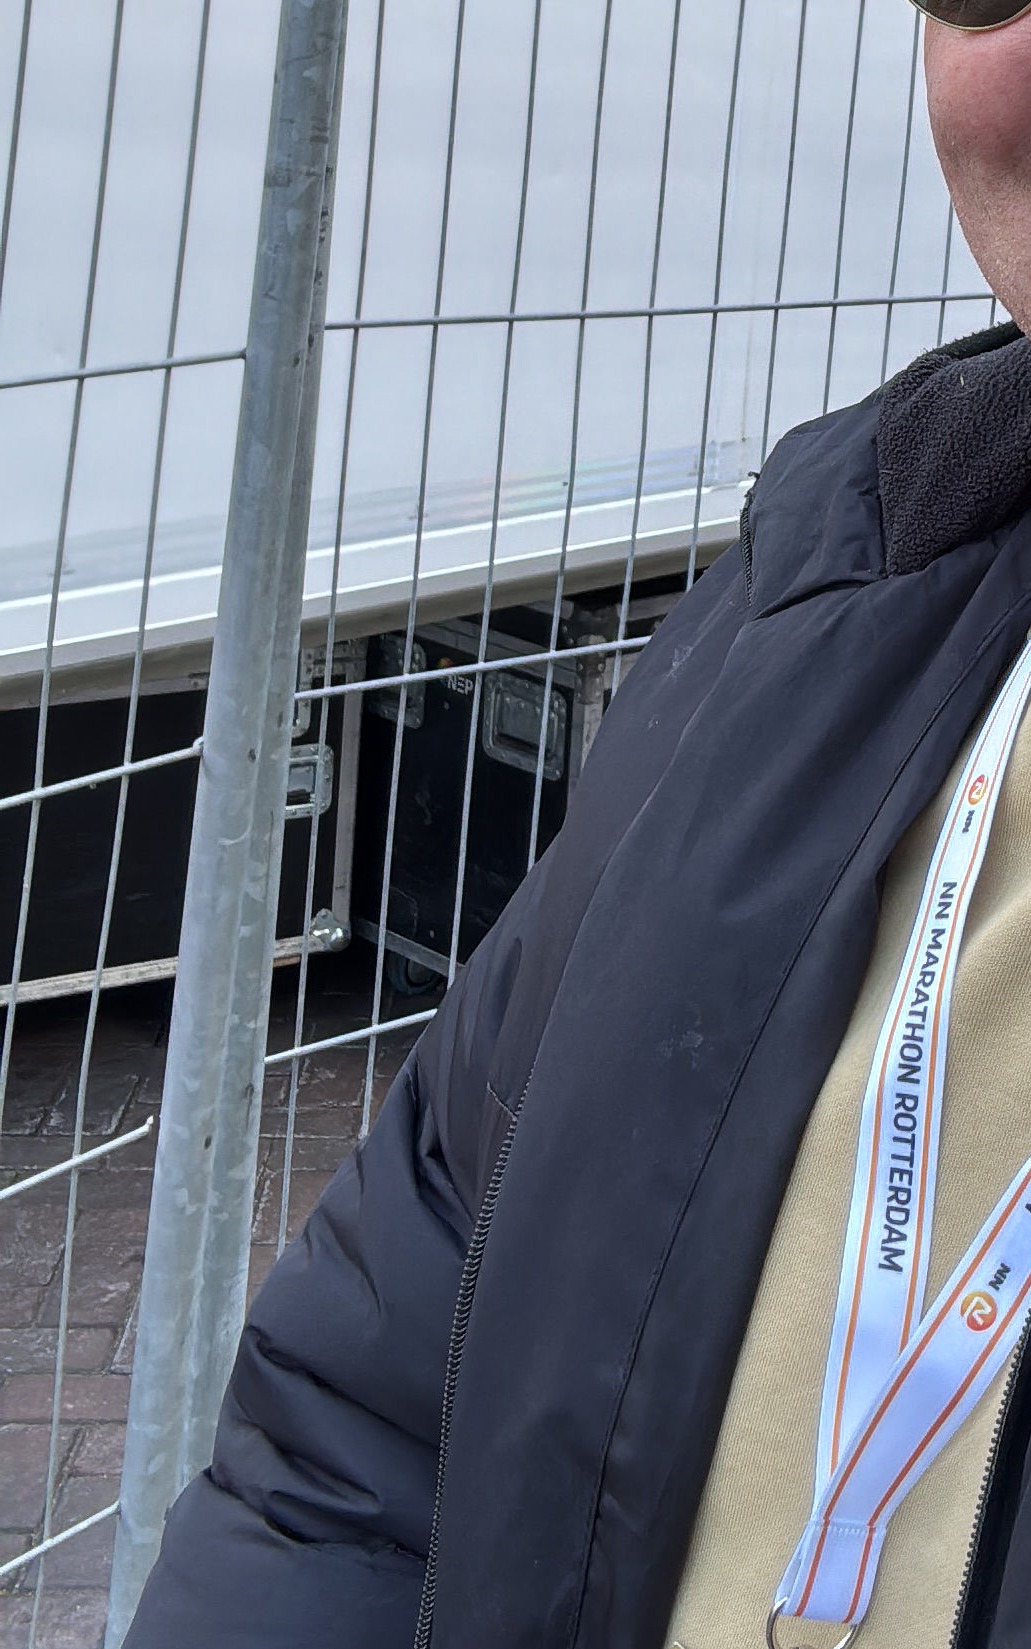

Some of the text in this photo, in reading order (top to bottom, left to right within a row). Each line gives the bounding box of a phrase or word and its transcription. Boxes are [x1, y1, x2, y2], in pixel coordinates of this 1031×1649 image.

[447, 672, 474, 696] NEP
[878, 881, 957, 1273] NN MARATHON ROTTERDAM
[988, 1262, 1011, 1292] NN
